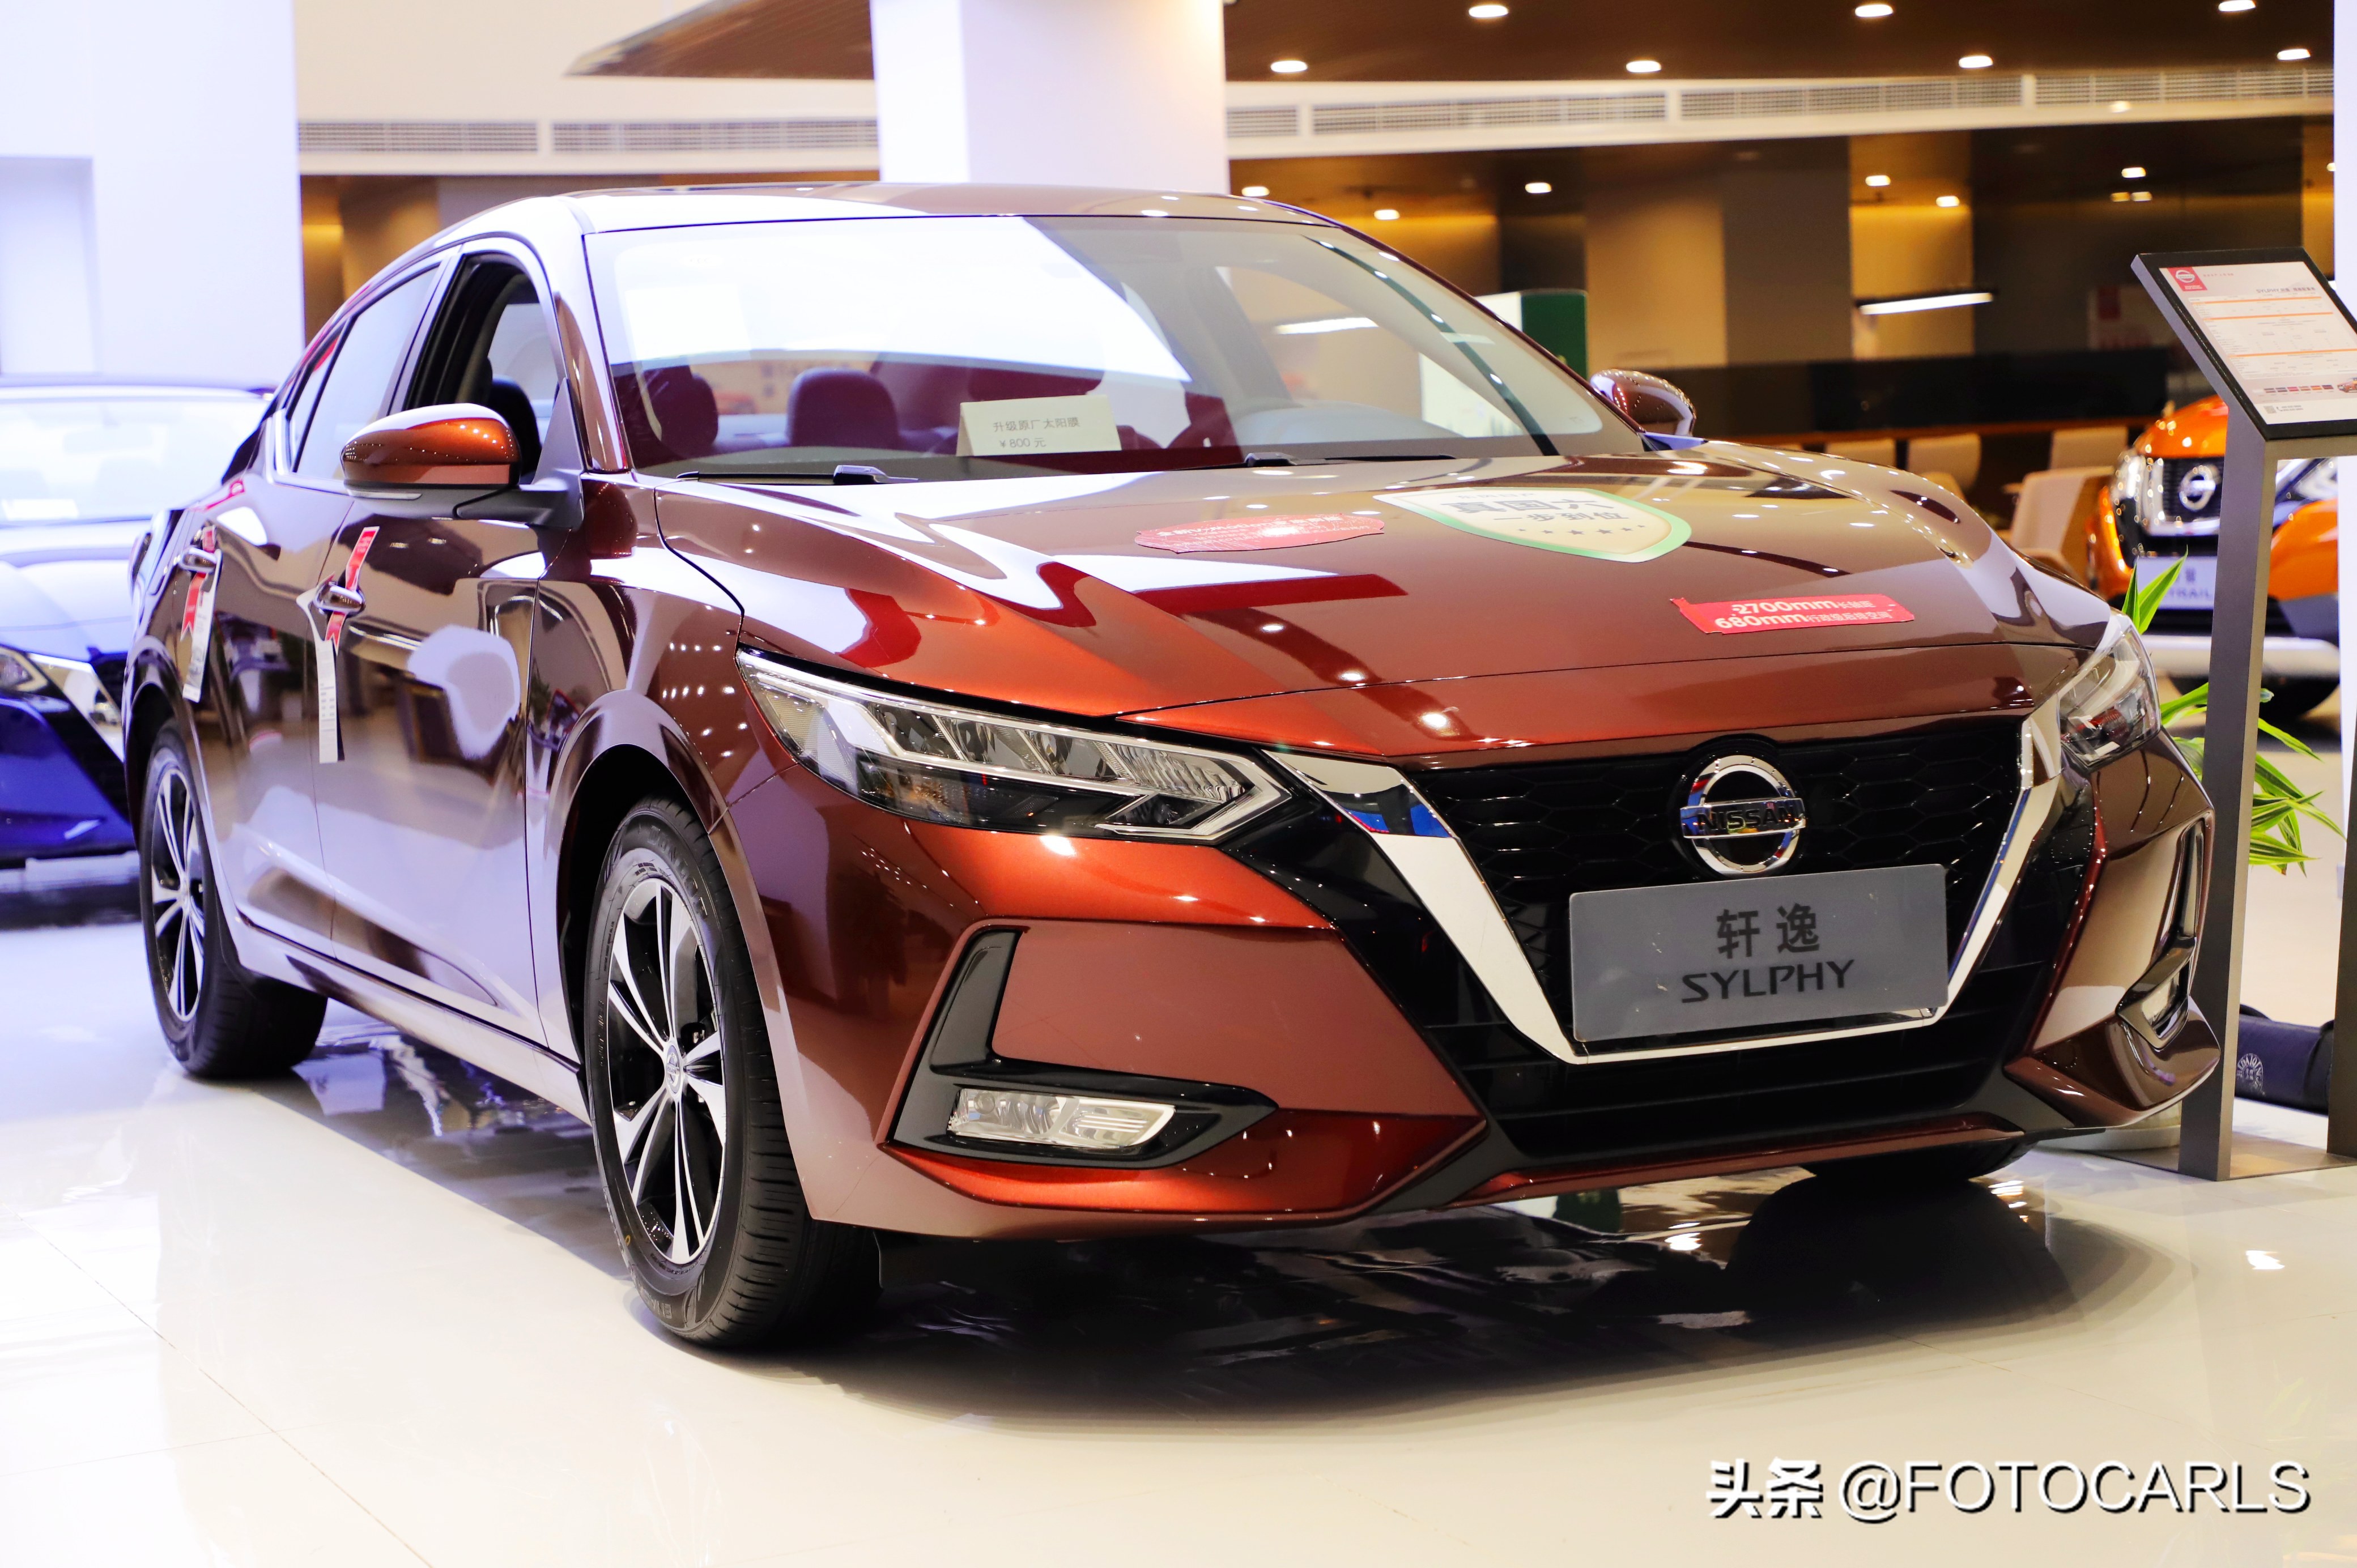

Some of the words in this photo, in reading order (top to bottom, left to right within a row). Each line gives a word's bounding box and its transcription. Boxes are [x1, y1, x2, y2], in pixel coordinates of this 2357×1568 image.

[993, 417, 1080, 432] 升级原厂太阳膜
[999, 437, 1031, 449] ¥800
[1035, 437, 1046, 448] 元
[1441, 498, 1615, 514] 真国六
[1493, 511, 1629, 522] 一步到位
[1699, 805, 1795, 831] NISSAN
[1716, 902, 1820, 959] 轩逸
[1680, 958, 1855, 1004] SYLPHY
